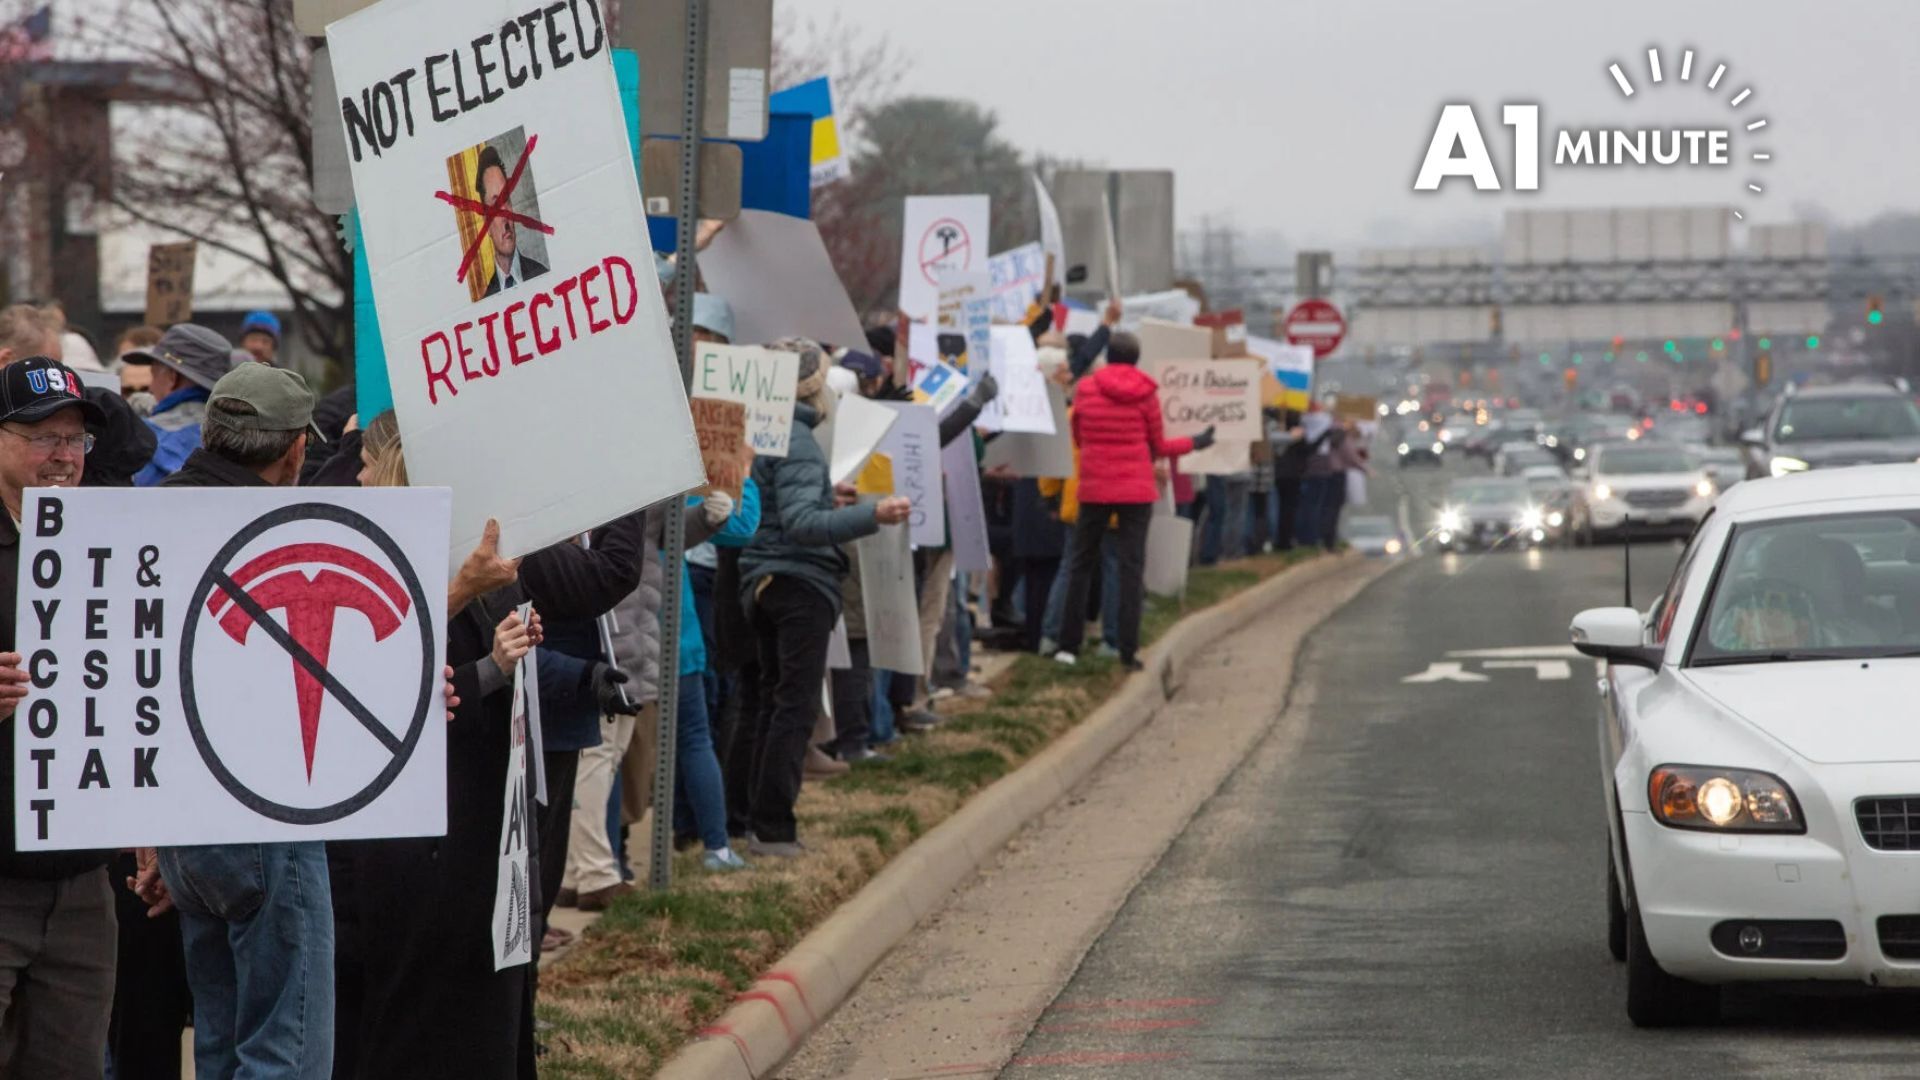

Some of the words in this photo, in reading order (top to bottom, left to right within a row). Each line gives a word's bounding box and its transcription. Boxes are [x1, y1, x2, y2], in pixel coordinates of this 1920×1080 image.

[342, 68, 416, 162] NOT
[425, 0, 604, 122] ELECTED
[26, 368, 81, 399] USA
[421, 256, 638, 404] REJECTED
[136, 544, 161, 587] &
[28, 496, 64, 840] BOYCOTT
[78, 547, 112, 789] TESLA
[134, 598, 164, 788] MUSK
